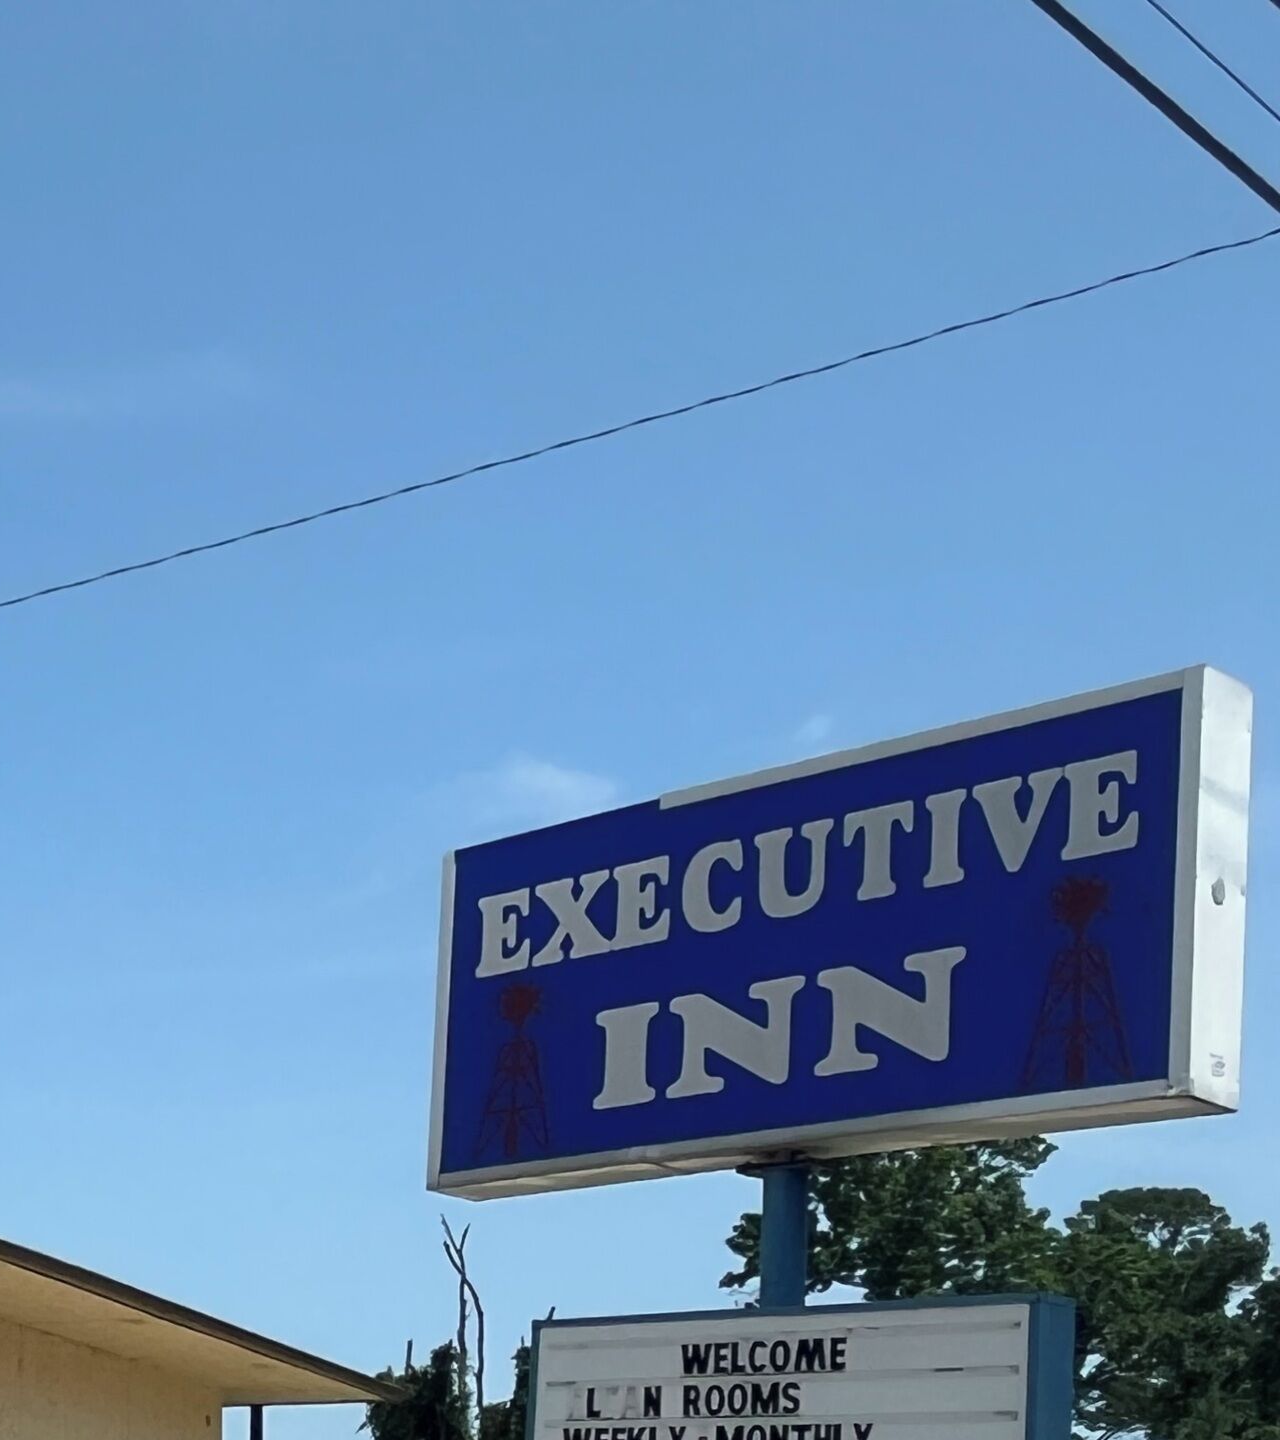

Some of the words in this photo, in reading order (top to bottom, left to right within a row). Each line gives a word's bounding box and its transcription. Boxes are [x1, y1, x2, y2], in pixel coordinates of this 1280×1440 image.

[474, 749, 1139, 979] EXECUTIVE
[592, 946, 967, 1110] INN
[681, 1337, 847, 1374] WELCOME
[682, 1382, 801, 1416] ROOMS
